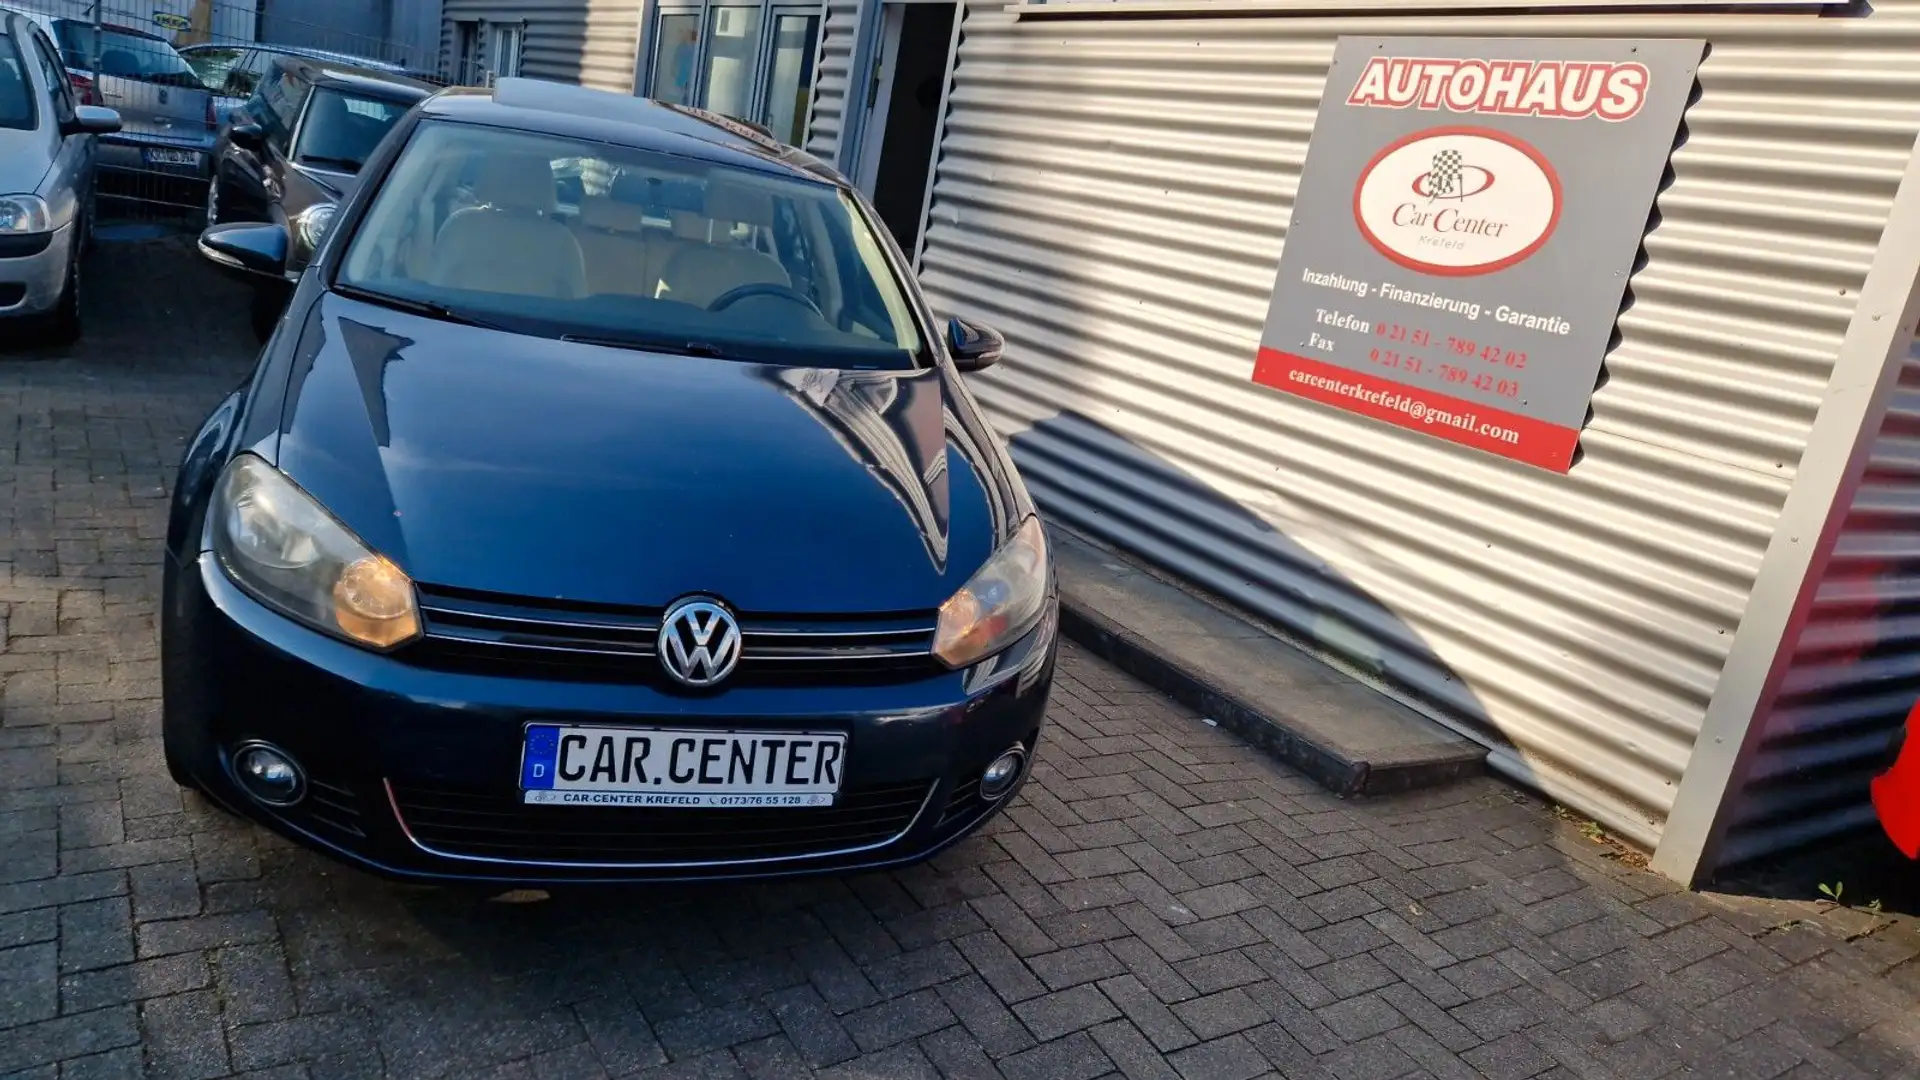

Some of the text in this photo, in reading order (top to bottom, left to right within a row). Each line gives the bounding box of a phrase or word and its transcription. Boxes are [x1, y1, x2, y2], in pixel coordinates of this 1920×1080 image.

[1346, 57, 1651, 122] AUTOHAUS
[1392, 202, 1508, 238] Car Center
[1419, 235, 1465, 250] Krefeld
[1302, 267, 1368, 298] Inzahlung
[1379, 282, 1481, 320] Finanzierung
[1495, 305, 1571, 335] Garantie
[1308, 331, 1335, 352] Fax
[1369, 347, 1380, 363] 0
[1382, 349, 1400, 368] 21
[1404, 355, 1422, 373] 51
[1440, 363, 1468, 384] 789
[1472, 374, 1493, 392] 42
[1497, 378, 1519, 398] 03
[1316, 308, 1370, 333] Telefon
[1375, 321, 1387, 336] 0
[1389, 323, 1407, 342] 21
[1411, 328, 1430, 347] 51
[1448, 336, 1476, 356] 789
[1480, 345, 1501, 363] 42
[1505, 350, 1528, 369] 02
[1288, 367, 1520, 445] carcenterkrefeld@gmail.com
[532, 733, 841, 786] D CAR.CENTER
[645, 796, 701, 805] KREFELD
[765, 796, 779, 805] 55
[783, 796, 801, 804] 128
